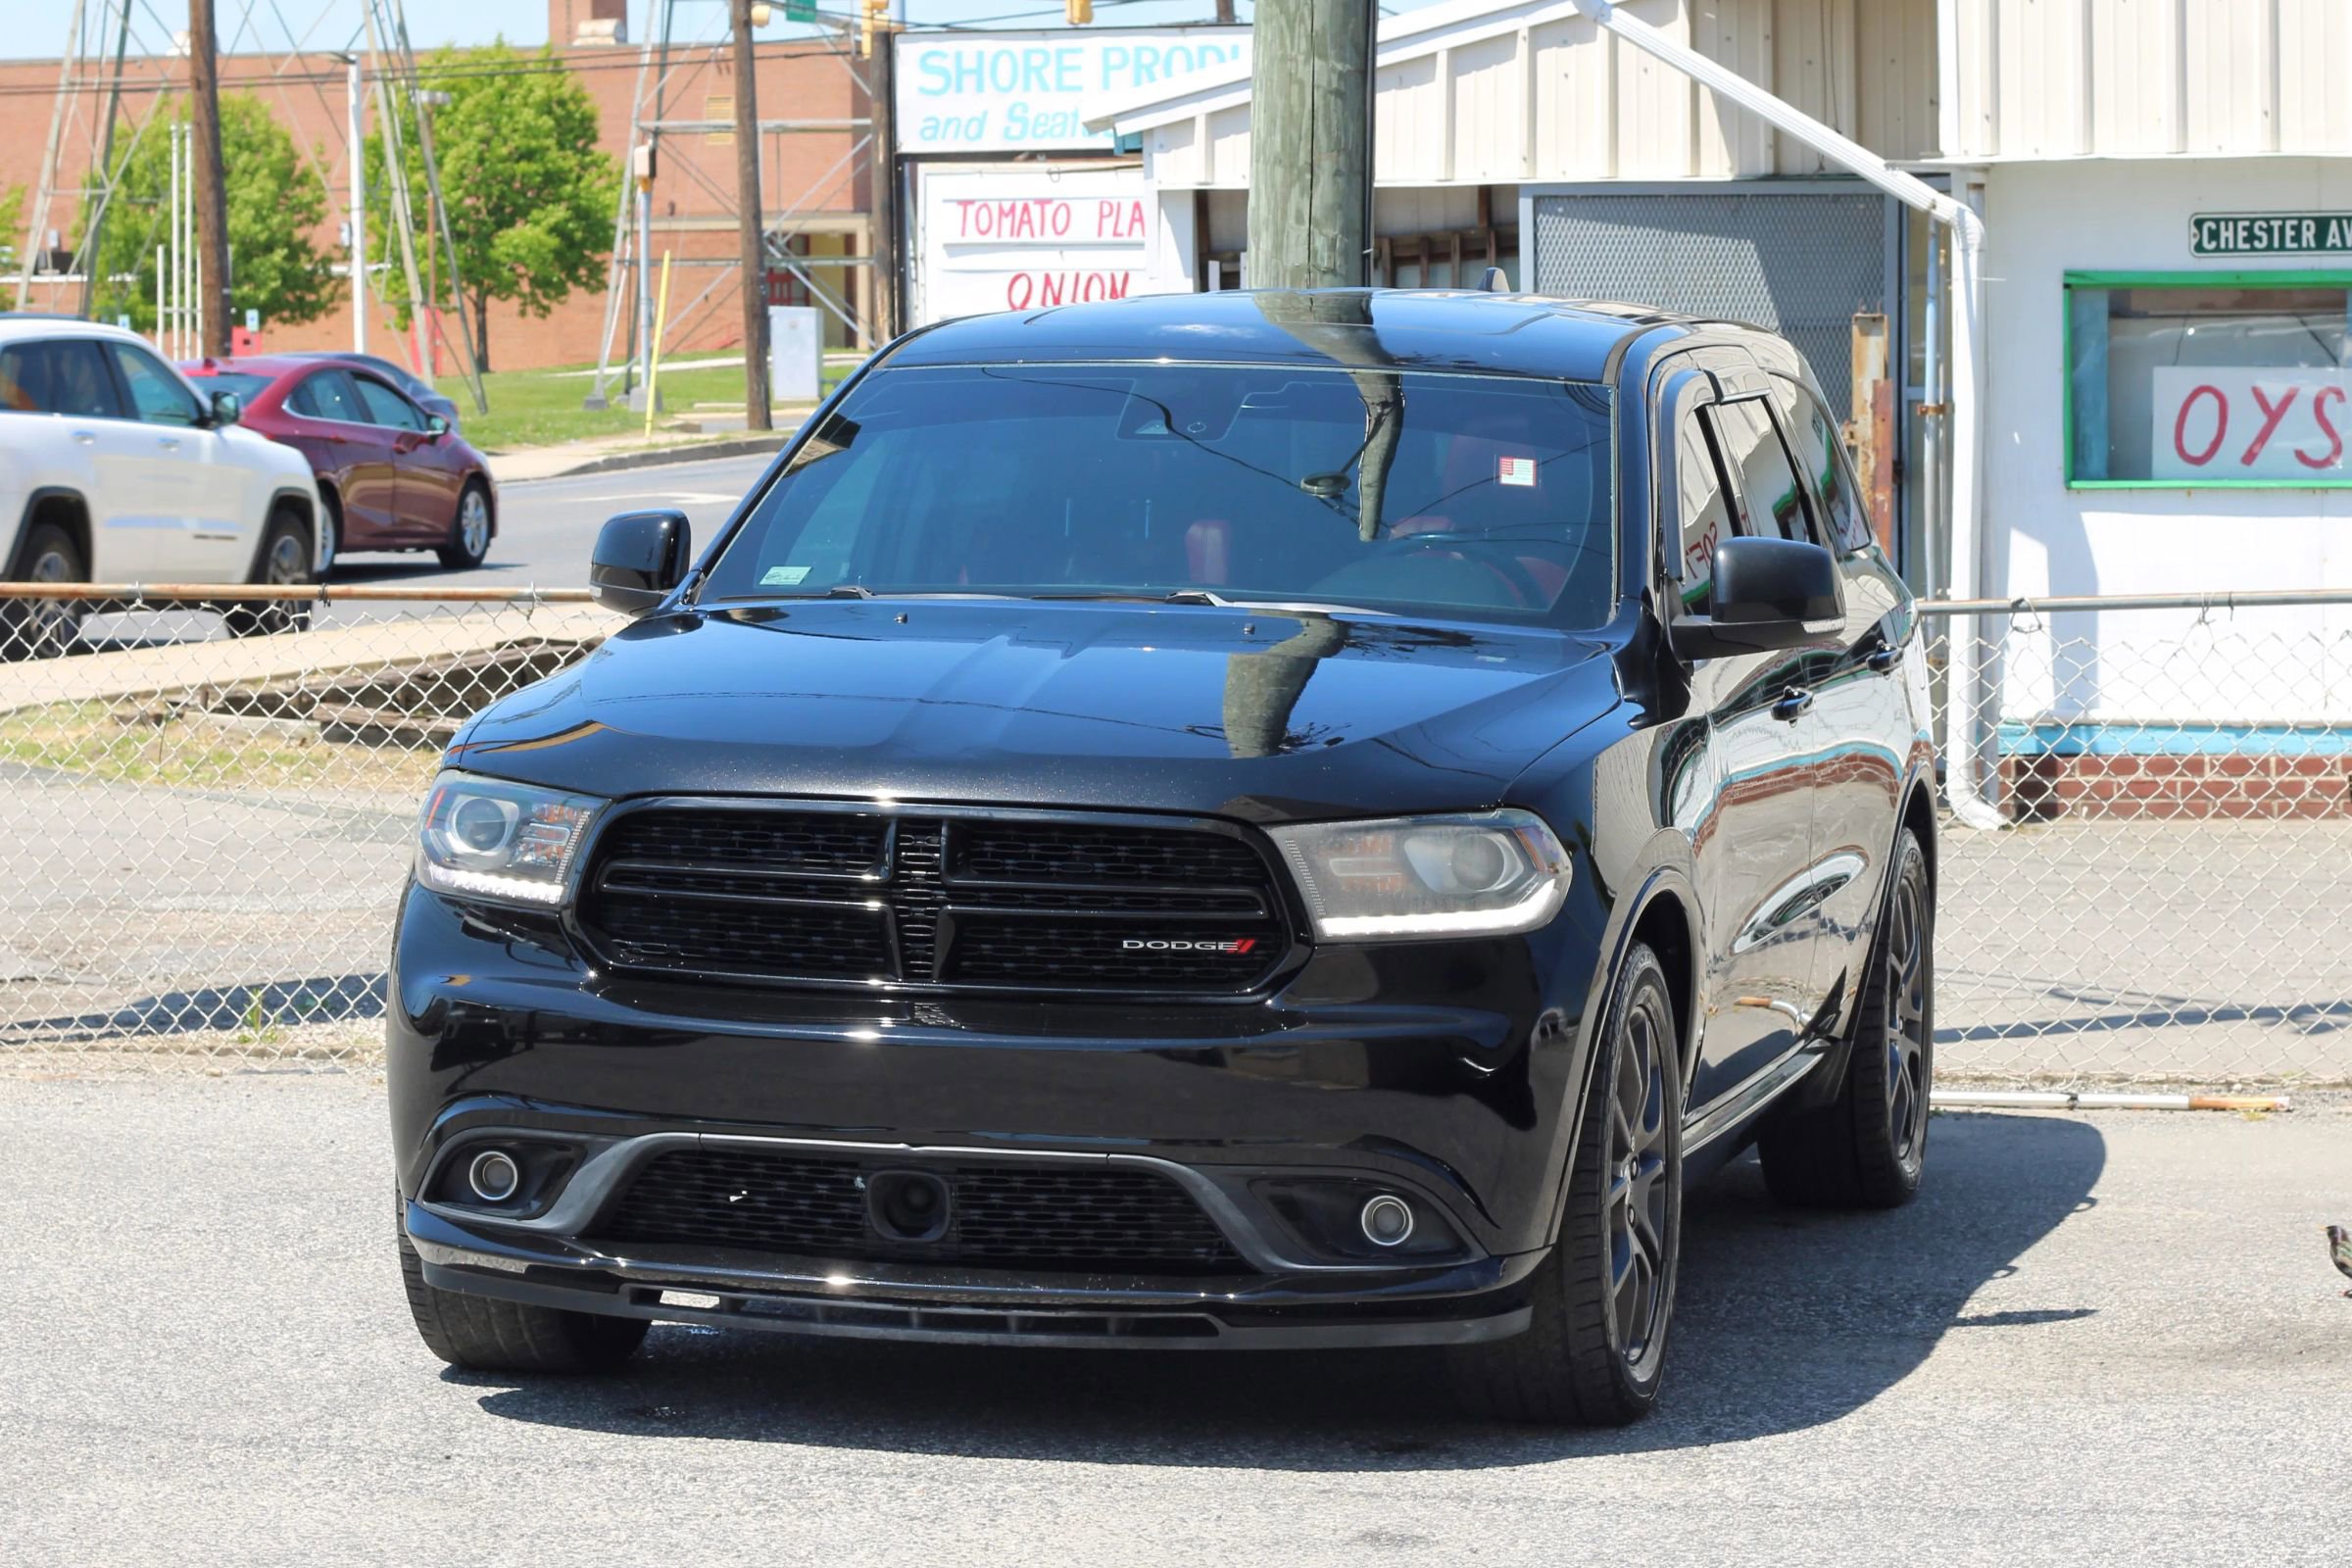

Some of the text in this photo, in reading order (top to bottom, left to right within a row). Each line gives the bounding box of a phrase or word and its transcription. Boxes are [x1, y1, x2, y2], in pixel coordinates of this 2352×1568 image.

[917, 48, 1084, 96] SHORE
[919, 110, 988, 141] and
[956, 200, 1145, 238] TOMATO PLA
[2201, 219, 2317, 250] CHESTER
[1007, 270, 1130, 311] ONION
[2173, 384, 2346, 469] OYS
[1122, 940, 1239, 951] DODGE
